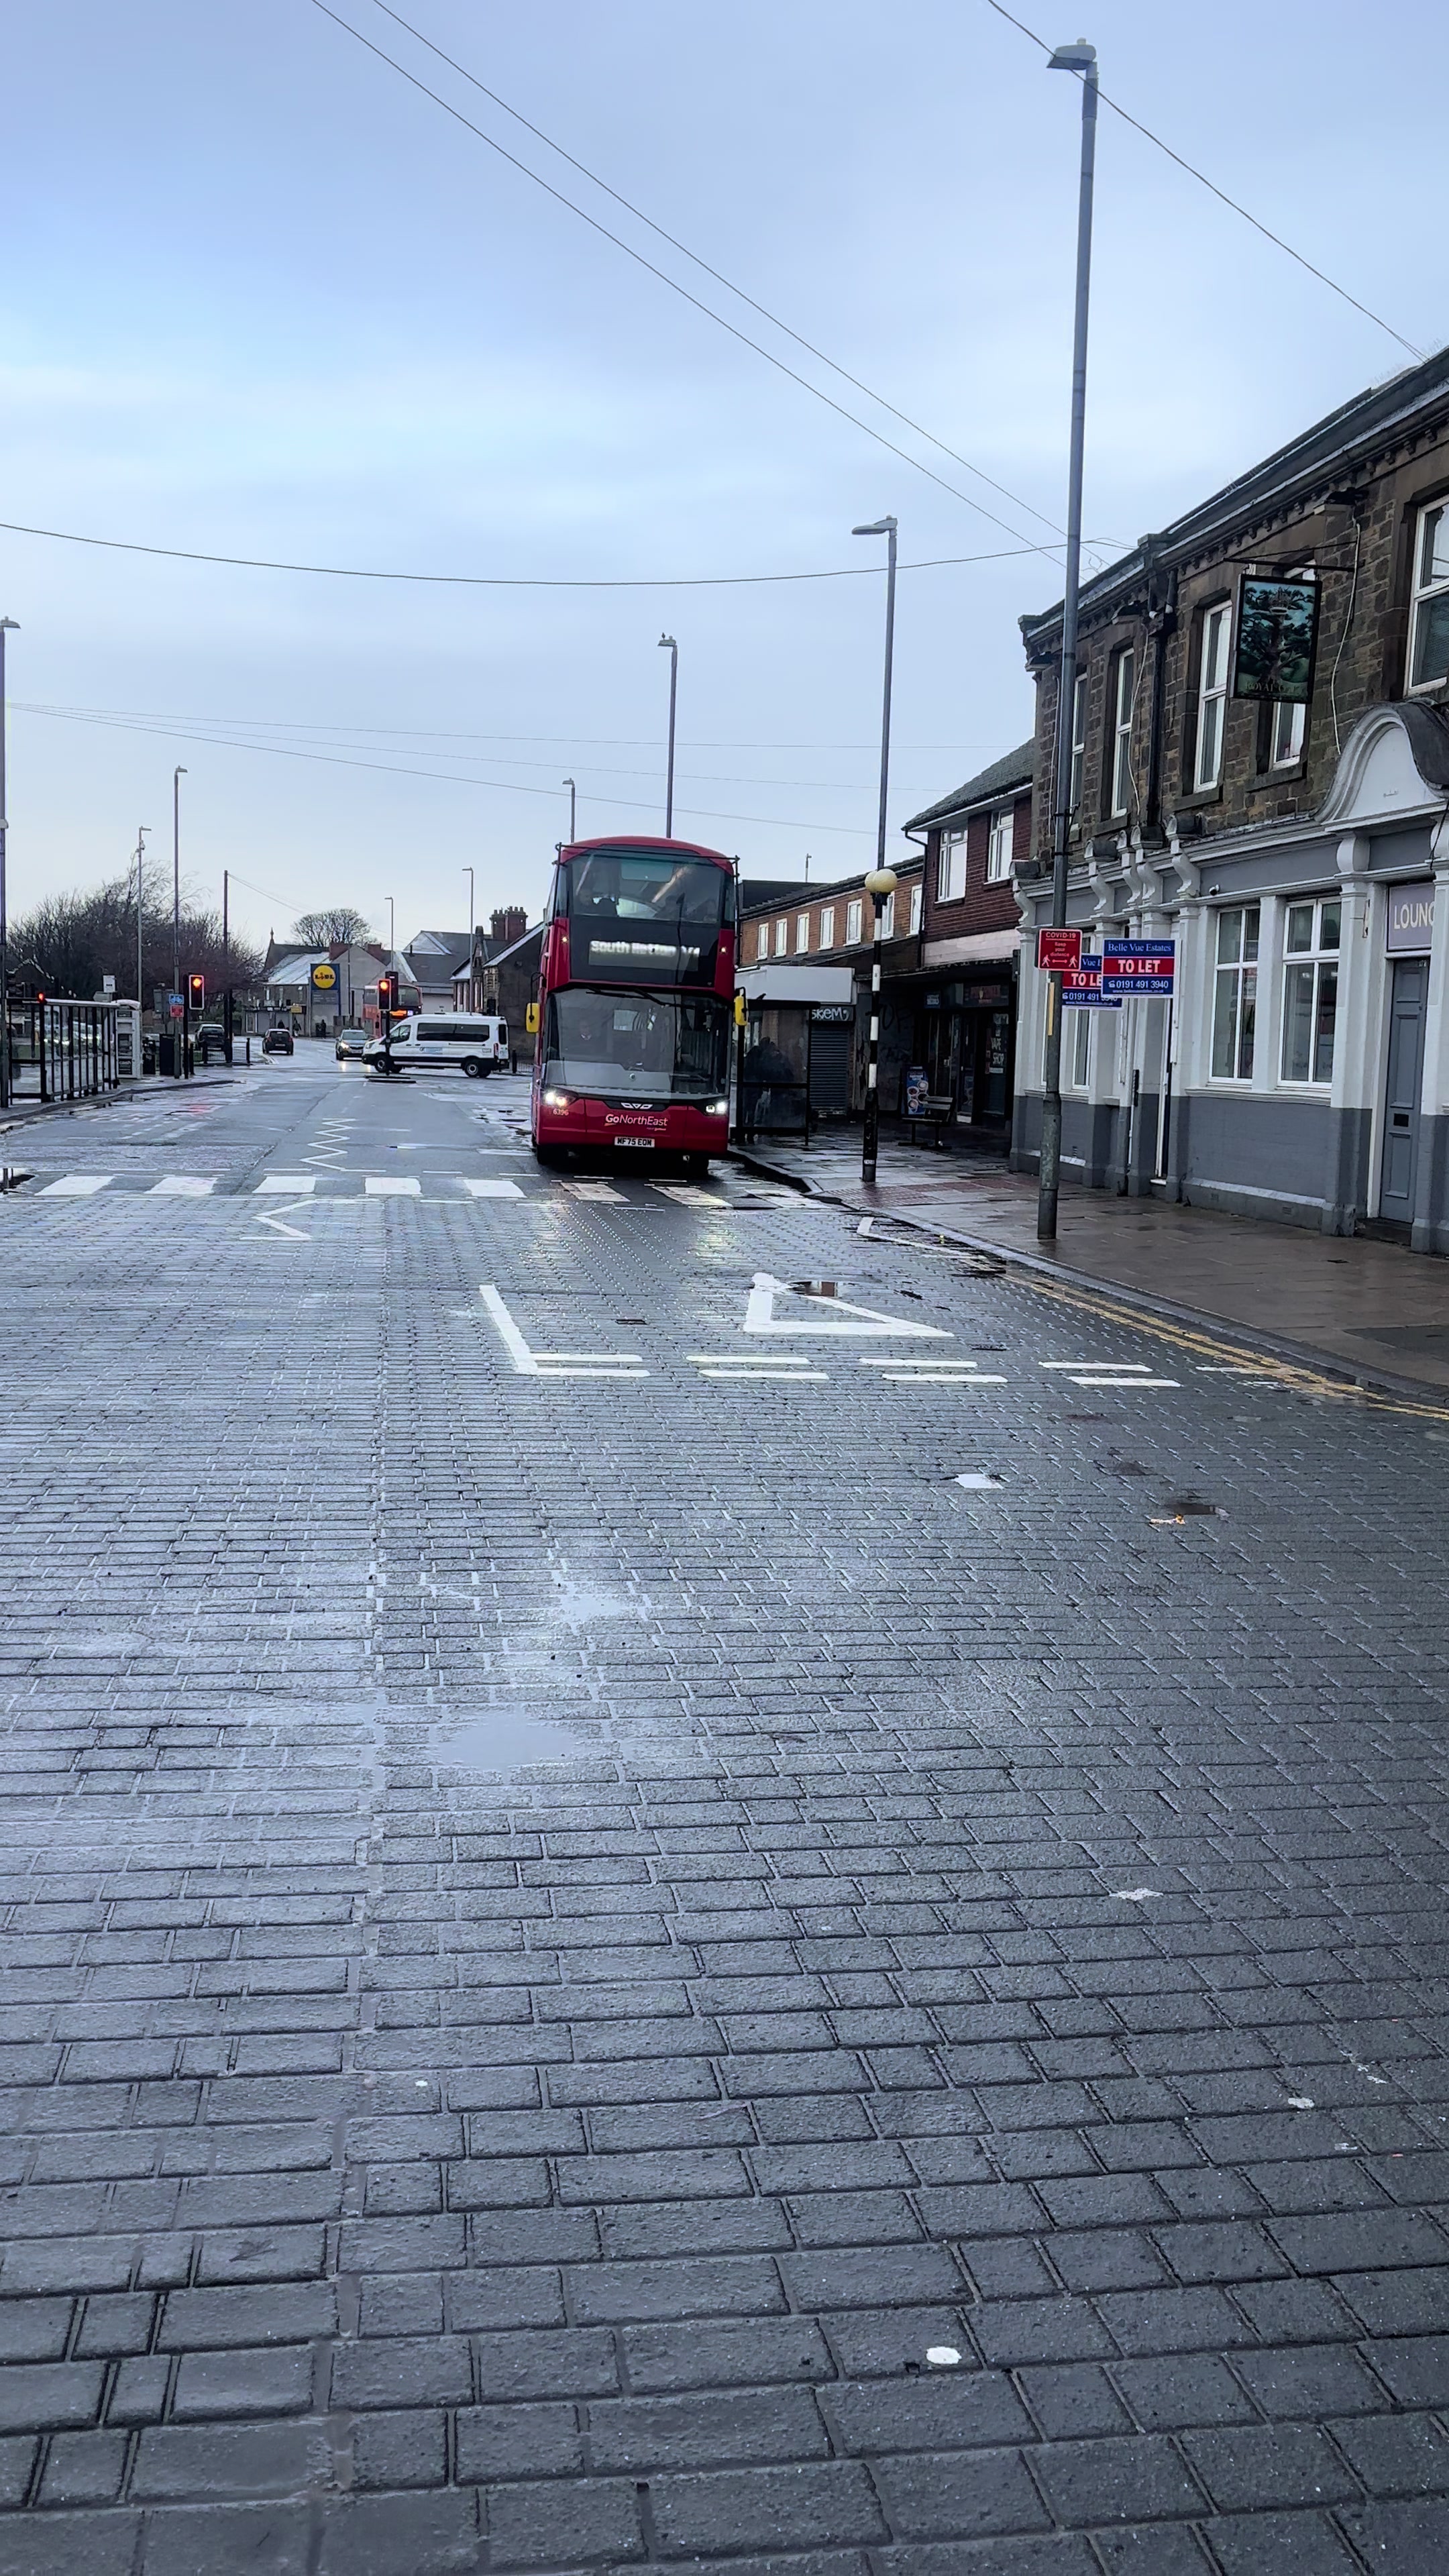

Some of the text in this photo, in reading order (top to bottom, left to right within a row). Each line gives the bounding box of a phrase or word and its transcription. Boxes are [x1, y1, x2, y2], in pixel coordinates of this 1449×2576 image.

[1394, 902, 1434, 929] LOUN
[590, 941, 630, 953] South
[1108, 943, 1171, 951] Belle Vue Estates
[1082, 958, 1097, 966] Vue
[1118, 959, 1134, 973] TO
[1138, 959, 1161, 973] LET
[1071, 973, 1102, 986] TO LE
[1116, 980, 1169, 989] 0191 491 3940
[604, 1114, 667, 1126] GoNorthEast
